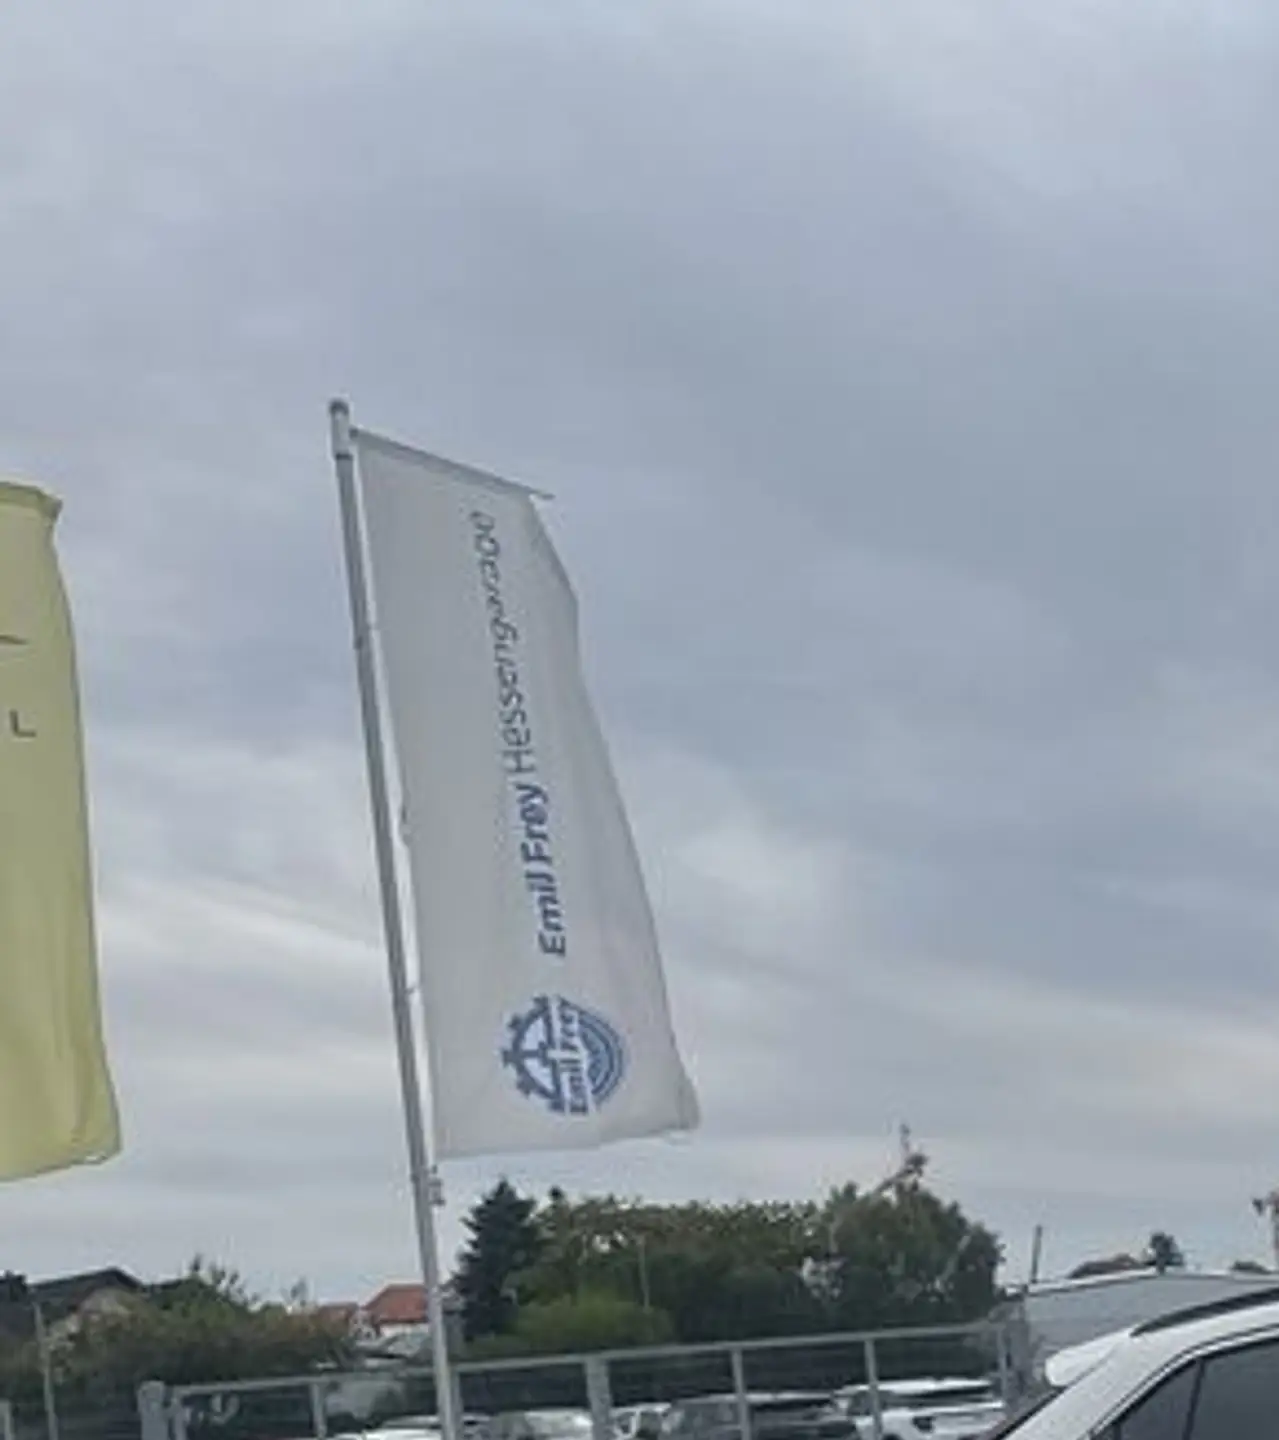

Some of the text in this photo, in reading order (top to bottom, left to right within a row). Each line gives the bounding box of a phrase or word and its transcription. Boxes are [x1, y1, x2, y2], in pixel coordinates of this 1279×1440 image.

[470, 510, 566, 957] Emil Frey Hessengarage
